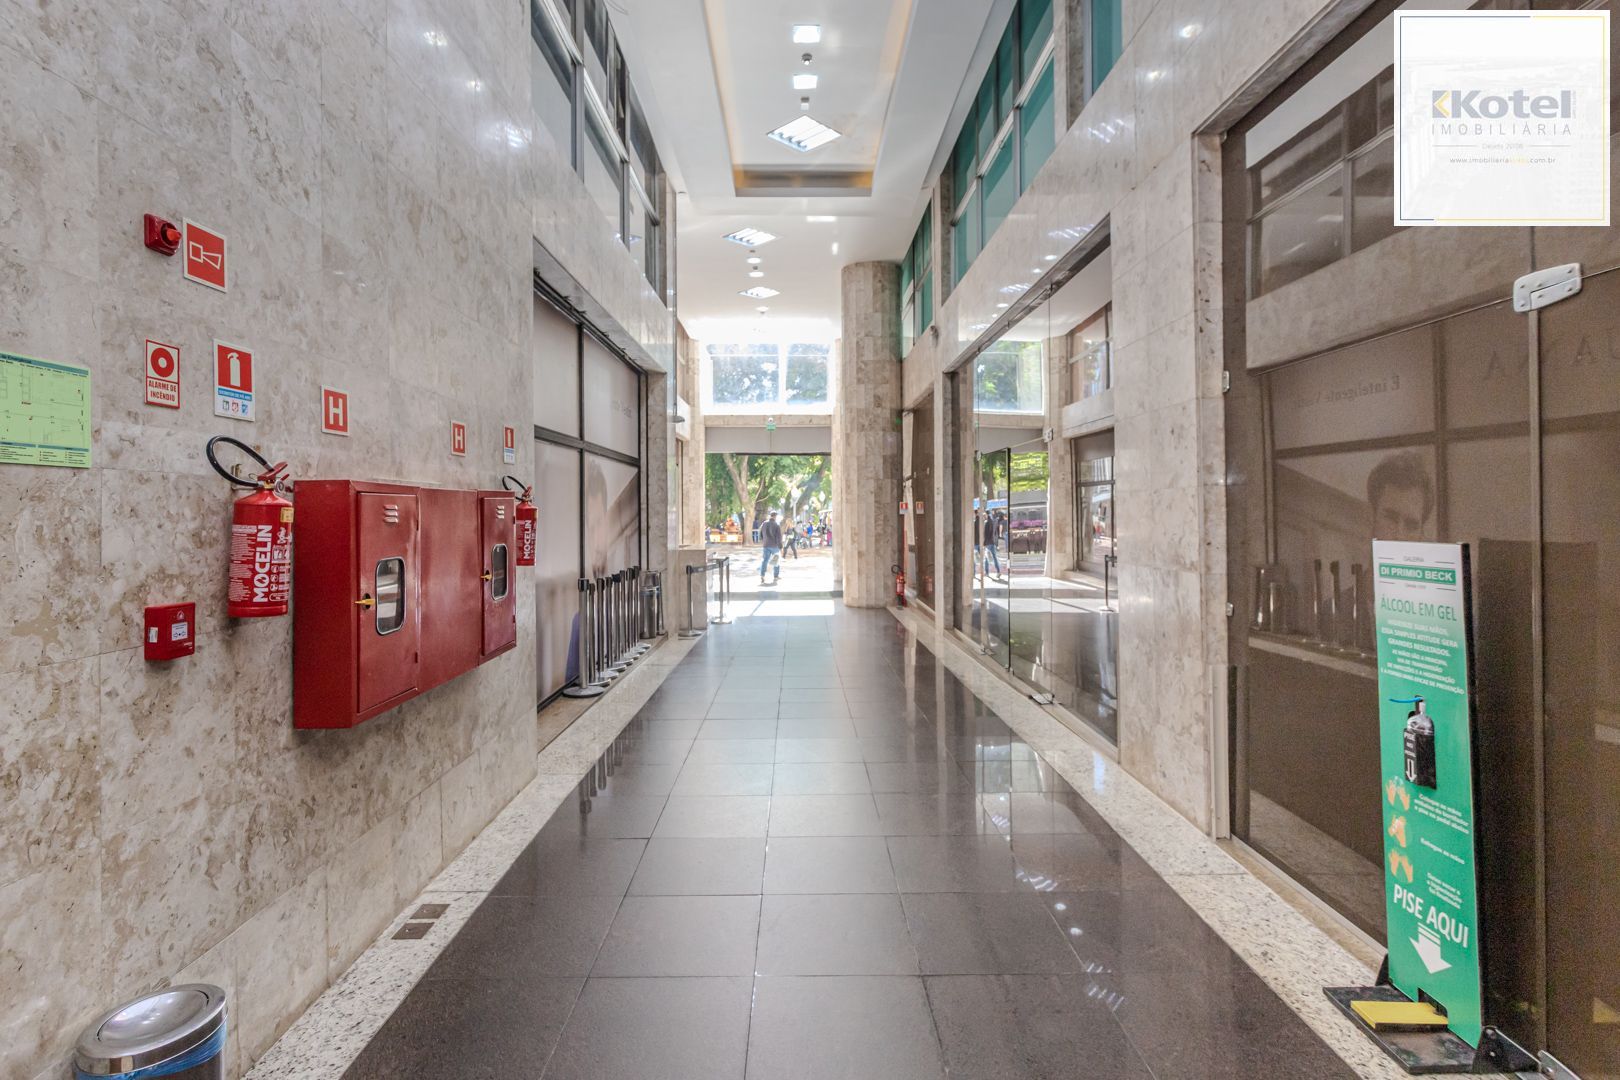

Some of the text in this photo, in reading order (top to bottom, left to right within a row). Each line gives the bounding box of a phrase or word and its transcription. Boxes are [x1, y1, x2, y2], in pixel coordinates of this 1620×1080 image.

[148, 380, 177, 393] ALARME DE
[150, 390, 176, 402] INCÊNDIO
[328, 395, 343, 427] H
[455, 428, 463, 449] H
[523, 519, 531, 559] MOCELIN
[252, 525, 273, 603] MOCELIN
[1381, 567, 1453, 582] DI PRIMIO BECK
[1380, 593, 1458, 622] ÁLCOOL EM GEL
[1393, 883, 1424, 919] PISE
[1426, 905, 1469, 948] AQUI
